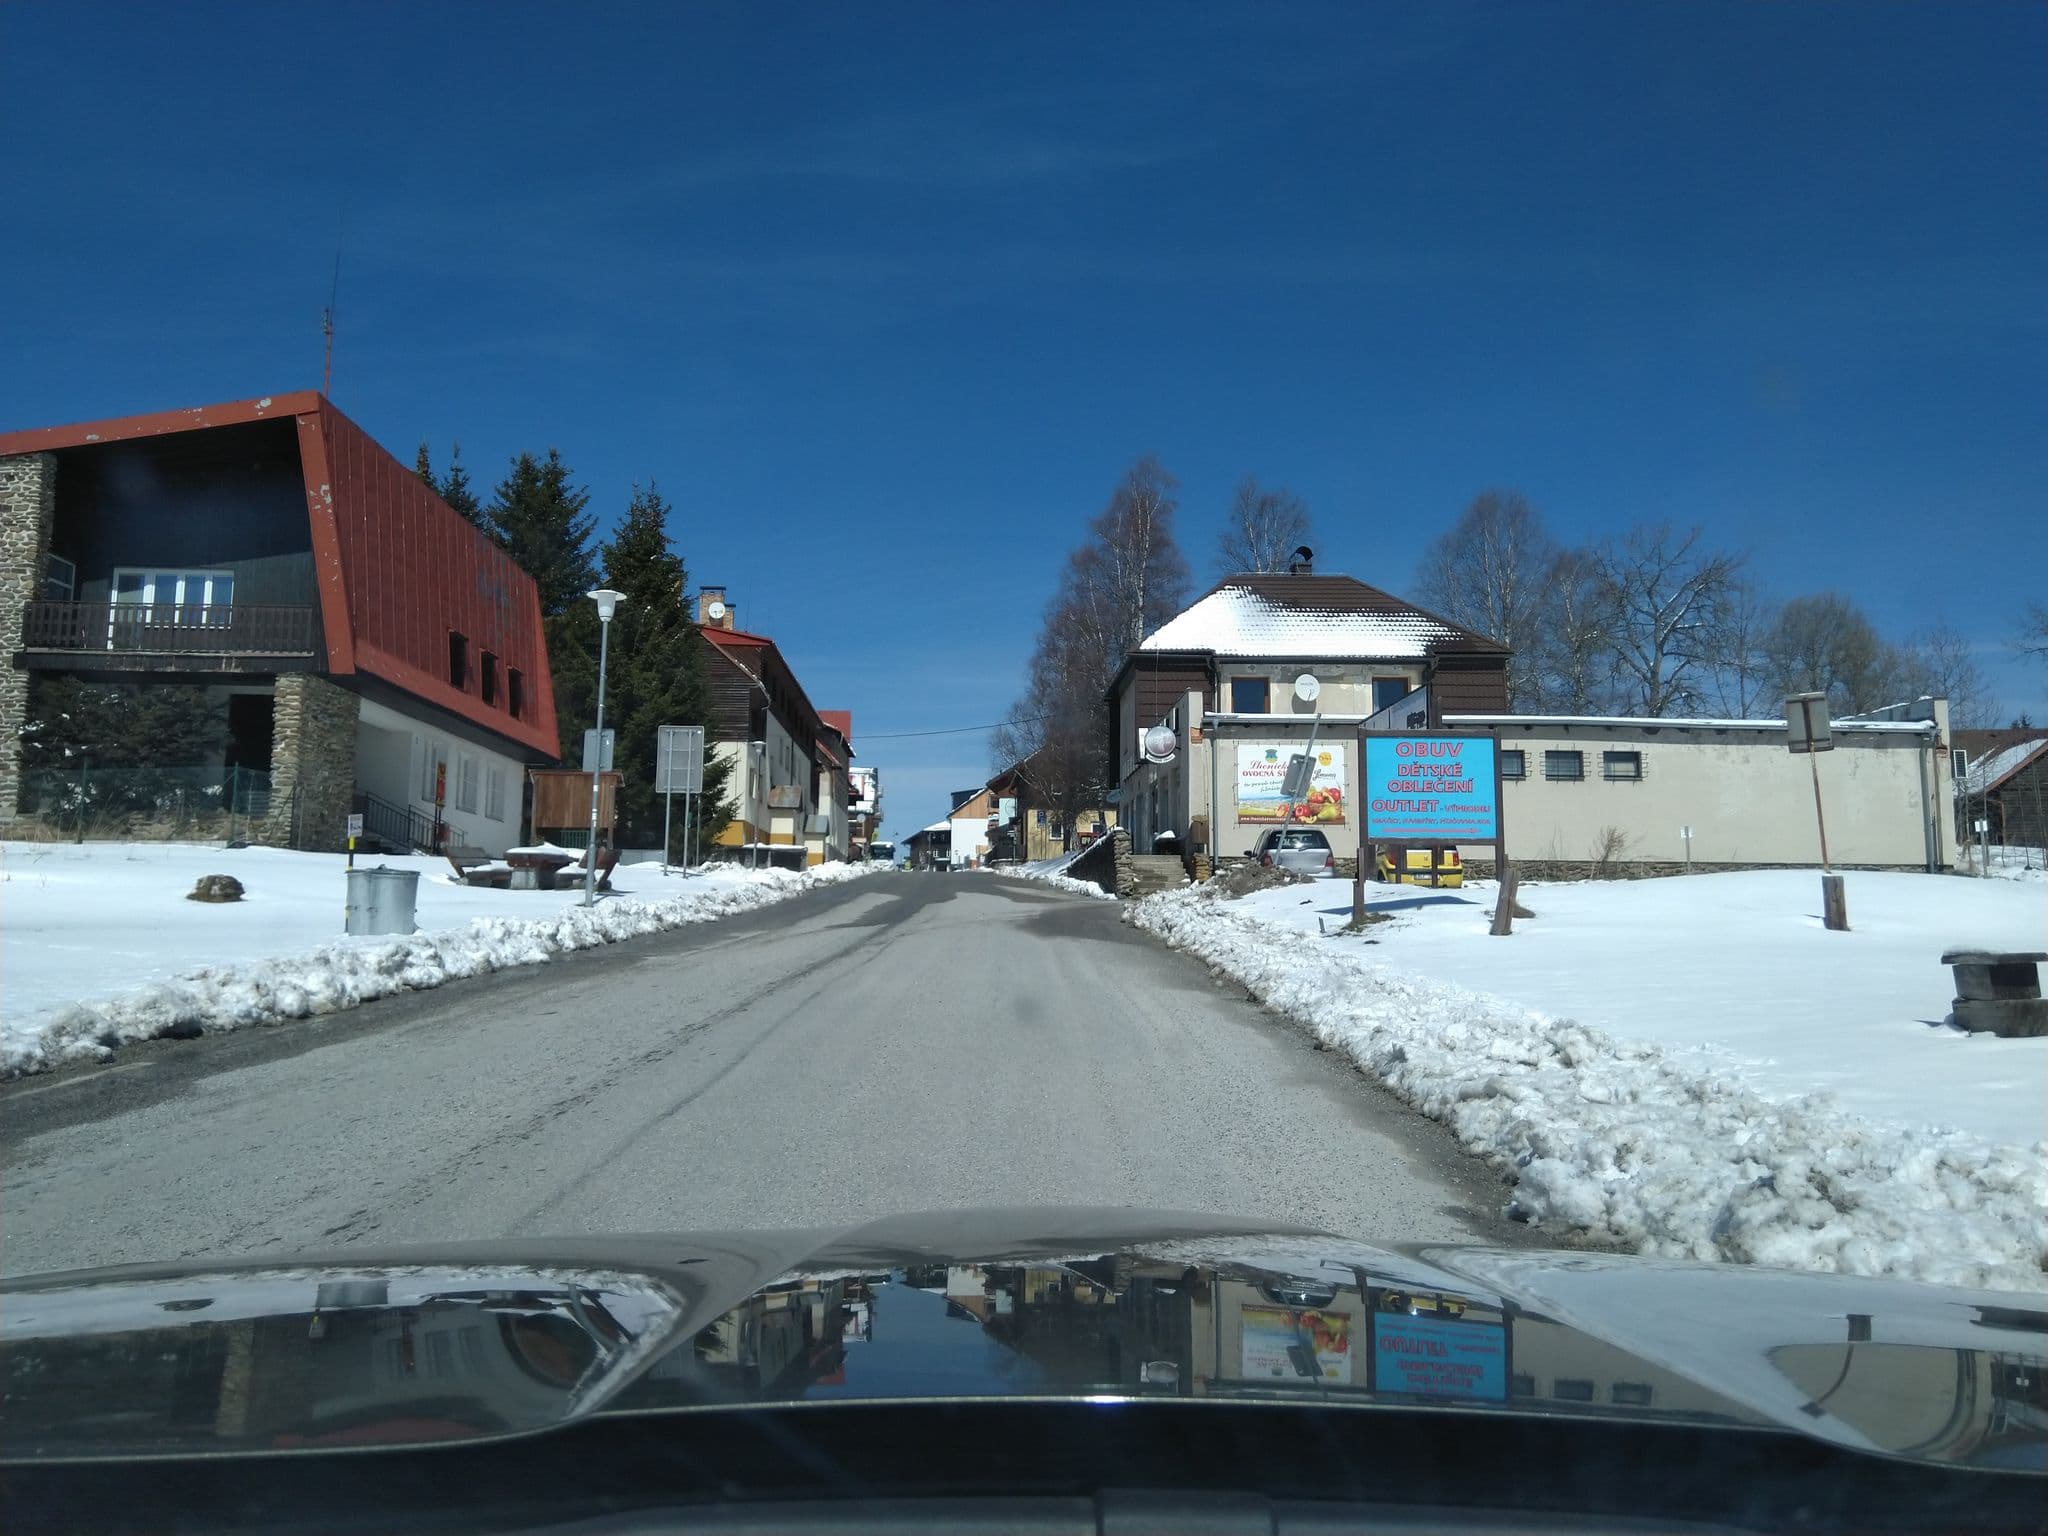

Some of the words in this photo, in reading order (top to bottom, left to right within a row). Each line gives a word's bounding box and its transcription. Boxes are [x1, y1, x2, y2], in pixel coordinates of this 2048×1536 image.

[1396, 742, 1464, 757] OBUV
[1398, 761, 1462, 777] DĚTSKÉ
[1388, 778, 1473, 793] OBLEČENÍ
[1372, 800, 1439, 812] OUTLET
